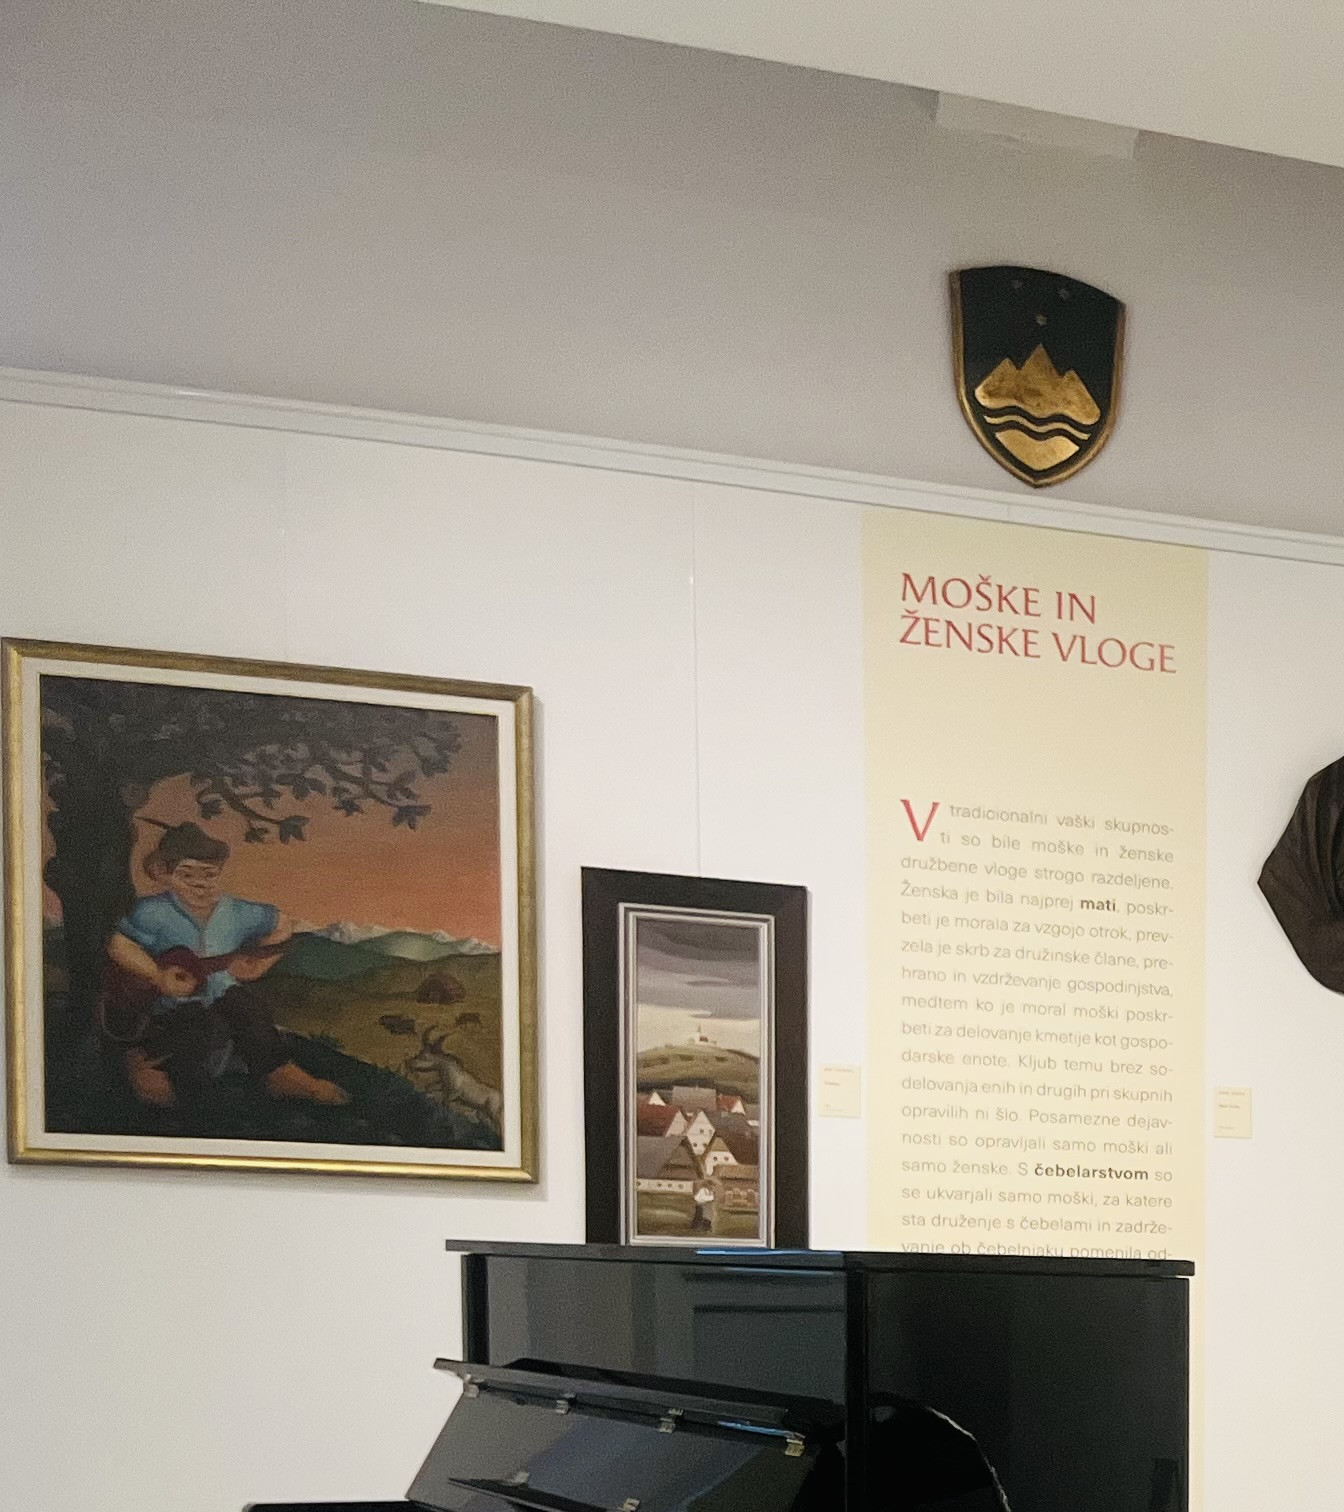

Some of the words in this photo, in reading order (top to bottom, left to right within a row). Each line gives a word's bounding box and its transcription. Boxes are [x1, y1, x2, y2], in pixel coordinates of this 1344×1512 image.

[901, 572, 1041, 617] MOŠKE
[1056, 591, 1096, 624] IN
[899, 609, 1041, 658] ŽENSKE
[1052, 632, 1177, 674] VLOGE
[900, 798, 940, 842] V
[950, 803, 1047, 824] tradicionalni
[1056, 813, 1094, 828] vaški
[1104, 817, 1173, 836] skupnos-
[941, 830, 950, 843] ti
[961, 835, 980, 845] so
[991, 834, 1020, 848] bile
[1031, 839, 1084, 854] moške
[1095, 843, 1108, 856] in
[1119, 844, 1173, 861] ženske
[900, 855, 977, 873] družbene
[984, 862, 1027, 880] vloge
[1034, 866, 1084, 885] strogo
[901, 879, 958, 899] Ženska
[965, 888, 978, 904] je
[986, 889, 1013, 903] bila
[1020, 893, 1073, 912] najprej
[1126, 902, 1173, 916] poskr-
[901, 911, 930, 925] beti
[936, 913, 949, 930] je
[954, 917, 1008, 930] morala
[1013, 922, 1030, 932] za
[1035, 923, 1084, 939] vzgojo
[1136, 931, 1173, 944] prev-
[901, 939, 932, 952] zela
[937, 941, 951, 957] je
[956, 942, 989, 956] skrb
[993, 947, 1010, 957] za
[1015, 946, 1089, 963] družinske
[1143, 957, 1173, 971] pre-
[901, 966, 946, 981] hrano
[953, 969, 966, 982] in
[973, 972, 1060, 992] vzdrževanje
[901, 995, 967, 1009] medtem
[976, 998, 993, 1011] ko
[1001, 999, 1014, 1016] je
[1022, 1002, 1065, 1015] moral
[1073, 1004, 1118, 1018] moški
[1126, 1008, 1173, 1023] poskr-
[901, 1020, 931, 1035] beti
[935, 1025, 952, 1036] za
[956, 1024, 1031, 1044] delovanje
[1035, 1029, 1090, 1048] kmetije
[1094, 1032, 1116, 1046] kot
[1120, 1037, 1173, 1052] gospo-
[901, 1048, 954, 1063] darske
[1018, 1055, 1056, 1072] Kljub
[1064, 1057, 1102, 1071] temu
[1110, 1059, 1142, 1073] brez
[1150, 1064, 1173, 1075] so-
[901, 1075, 977, 1095] delovanja
[981, 1081, 1015, 1093] enih
[1019, 1082, 1032, 1094] in
[1036, 1082, 1086, 1100] drugih
[1090, 1086, 1109, 1102] pri
[1113, 1087, 1172, 1104] skupnih
[901, 1105, 968, 1120] opravilih
[975, 1107, 988, 1119] ni
[1029, 1109, 1120, 1125] Posamezne
[1127, 1113, 1172, 1130] dejav-
[901, 1132, 941, 1145] nosti
[948, 1136, 967, 1146] so
[975, 1135, 1045, 1152] opravljali
[1053, 1139, 1095, 1150] samo
[1103, 1139, 1148, 1153] moški
[1155, 1141, 1172, 1153] ali
[901, 1160, 946, 1171] samo
[1018, 1162, 1027, 1175] S
[1034, 1162, 1148, 1179] čebelarstvom
[1155, 1170, 1172, 1180] so
[901, 1188, 920, 1198] se
[926, 1186, 992, 1204] ukvarjali
[998, 1191, 1041, 1202] samo
[1103, 1195, 1119, 1205] za
[1126, 1193, 1172, 1207] katere
[902, 1212, 925, 1225] sta
[931, 1213, 1000, 1231] druženje
[1007, 1218, 1014, 1228] s
[1020, 1215, 1091, 1230] čebelami
[1097, 1218, 1110, 1231] in
[1116, 1219, 1172, 1232] zadrže-
